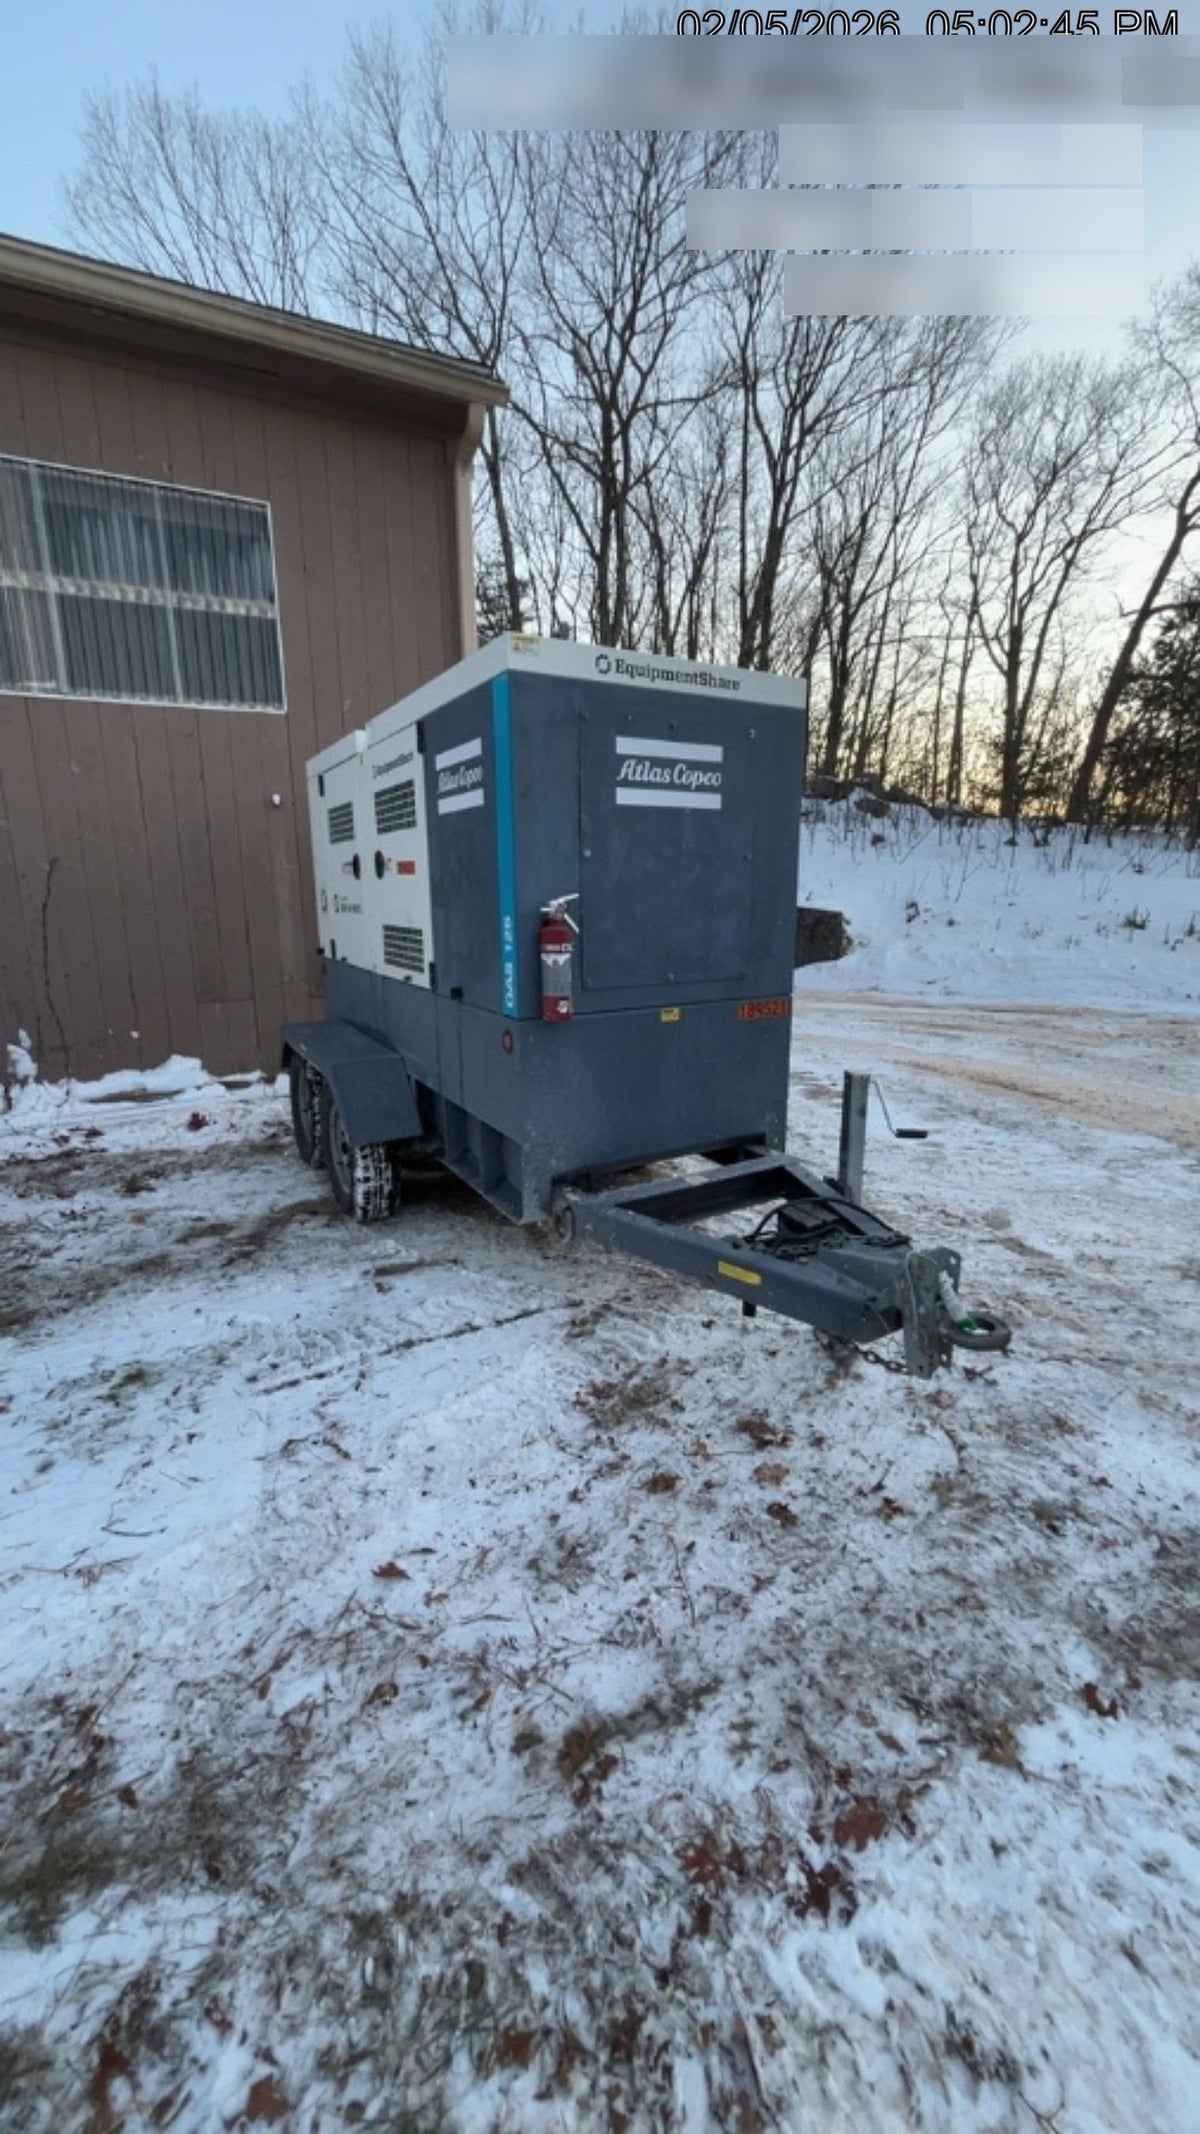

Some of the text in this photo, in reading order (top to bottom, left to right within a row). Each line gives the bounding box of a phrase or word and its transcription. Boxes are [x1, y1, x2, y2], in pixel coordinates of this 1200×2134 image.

[614, 658, 741, 691] EquipmentShare
[616, 759, 722, 790] Atlas Copco
